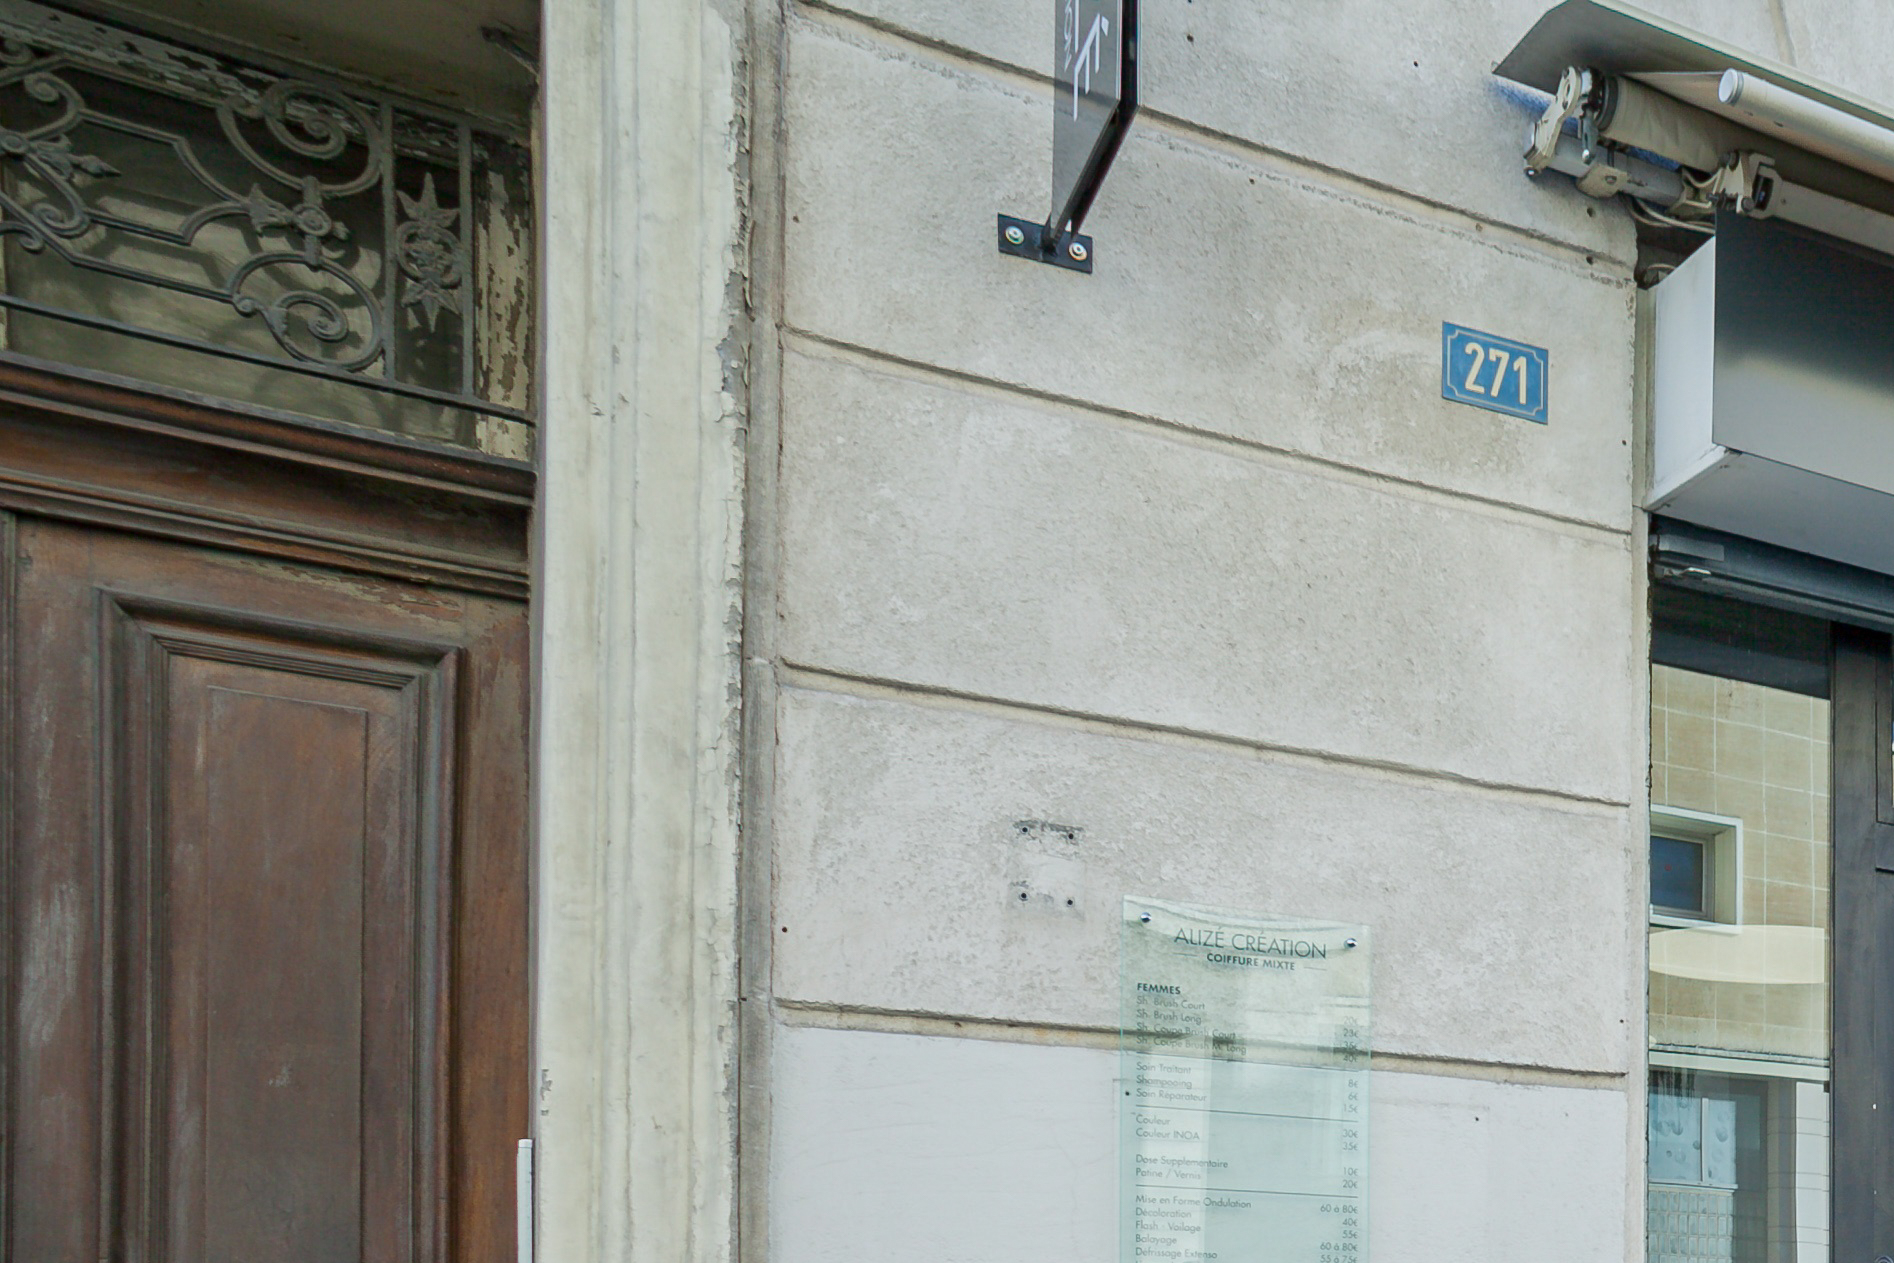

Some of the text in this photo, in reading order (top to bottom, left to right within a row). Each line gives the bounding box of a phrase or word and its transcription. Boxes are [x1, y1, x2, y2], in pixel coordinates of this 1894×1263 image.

[1464, 341, 1527, 405] 271
[1174, 925, 1327, 959] ALIZÉ CRÉATION
[1206, 953, 1295, 971] COIFFURE MIXTE
[1136, 982, 1181, 995] FEMMES
[1153, 997, 1179, 1008] Brush
[1181, 999, 1206, 1011] Court
[1153, 1010, 1359, 1038] Brush Long 23€
[1185, 1026, 1209, 1037] Brush
[1212, 1029, 1236, 1039] Court
[1153, 1036, 1183, 1048] Coupe
[1185, 1039, 1209, 1050] Brush
[1227, 1044, 1247, 1056] Long
[1136, 1061, 1156, 1072] Soin
[1348, 1078, 1359, 1089] 8€
[1136, 1074, 1359, 1101] Shampooing 6€
[1136, 1087, 1156, 1098] Soin
[1343, 1103, 1359, 1114] 15€
[1135, 1113, 1359, 1139] Couleur 30€
[1135, 1127, 1359, 1152] Couleur INOA 35€
[1135, 1153, 1159, 1165] Dose
[1343, 1166, 1359, 1177] 10€
[1135, 1167, 1359, 1189] Patine Vernis 20€
[1135, 1194, 1157, 1204] Mise
[1159, 1197, 1171, 1205] en
[1173, 1195, 1201, 1206] Forme
[1202, 1196, 1252, 1209] Ondulation
[1320, 1203, 1332, 1213] 60
[1342, 1204, 1359, 1214] 80€
[1135, 1206, 1359, 1227] Décoloration 40€
[1135, 1219, 1359, 1240] Flash Voilage 55€
[1135, 1233, 1178, 1247] Balayage
[1320, 1241, 1332, 1251] 60
[1342, 1242, 1359, 1253] 80€
[1184, 1248, 1218, 1259] Extenso
[1320, 1254, 1332, 1263] 55
